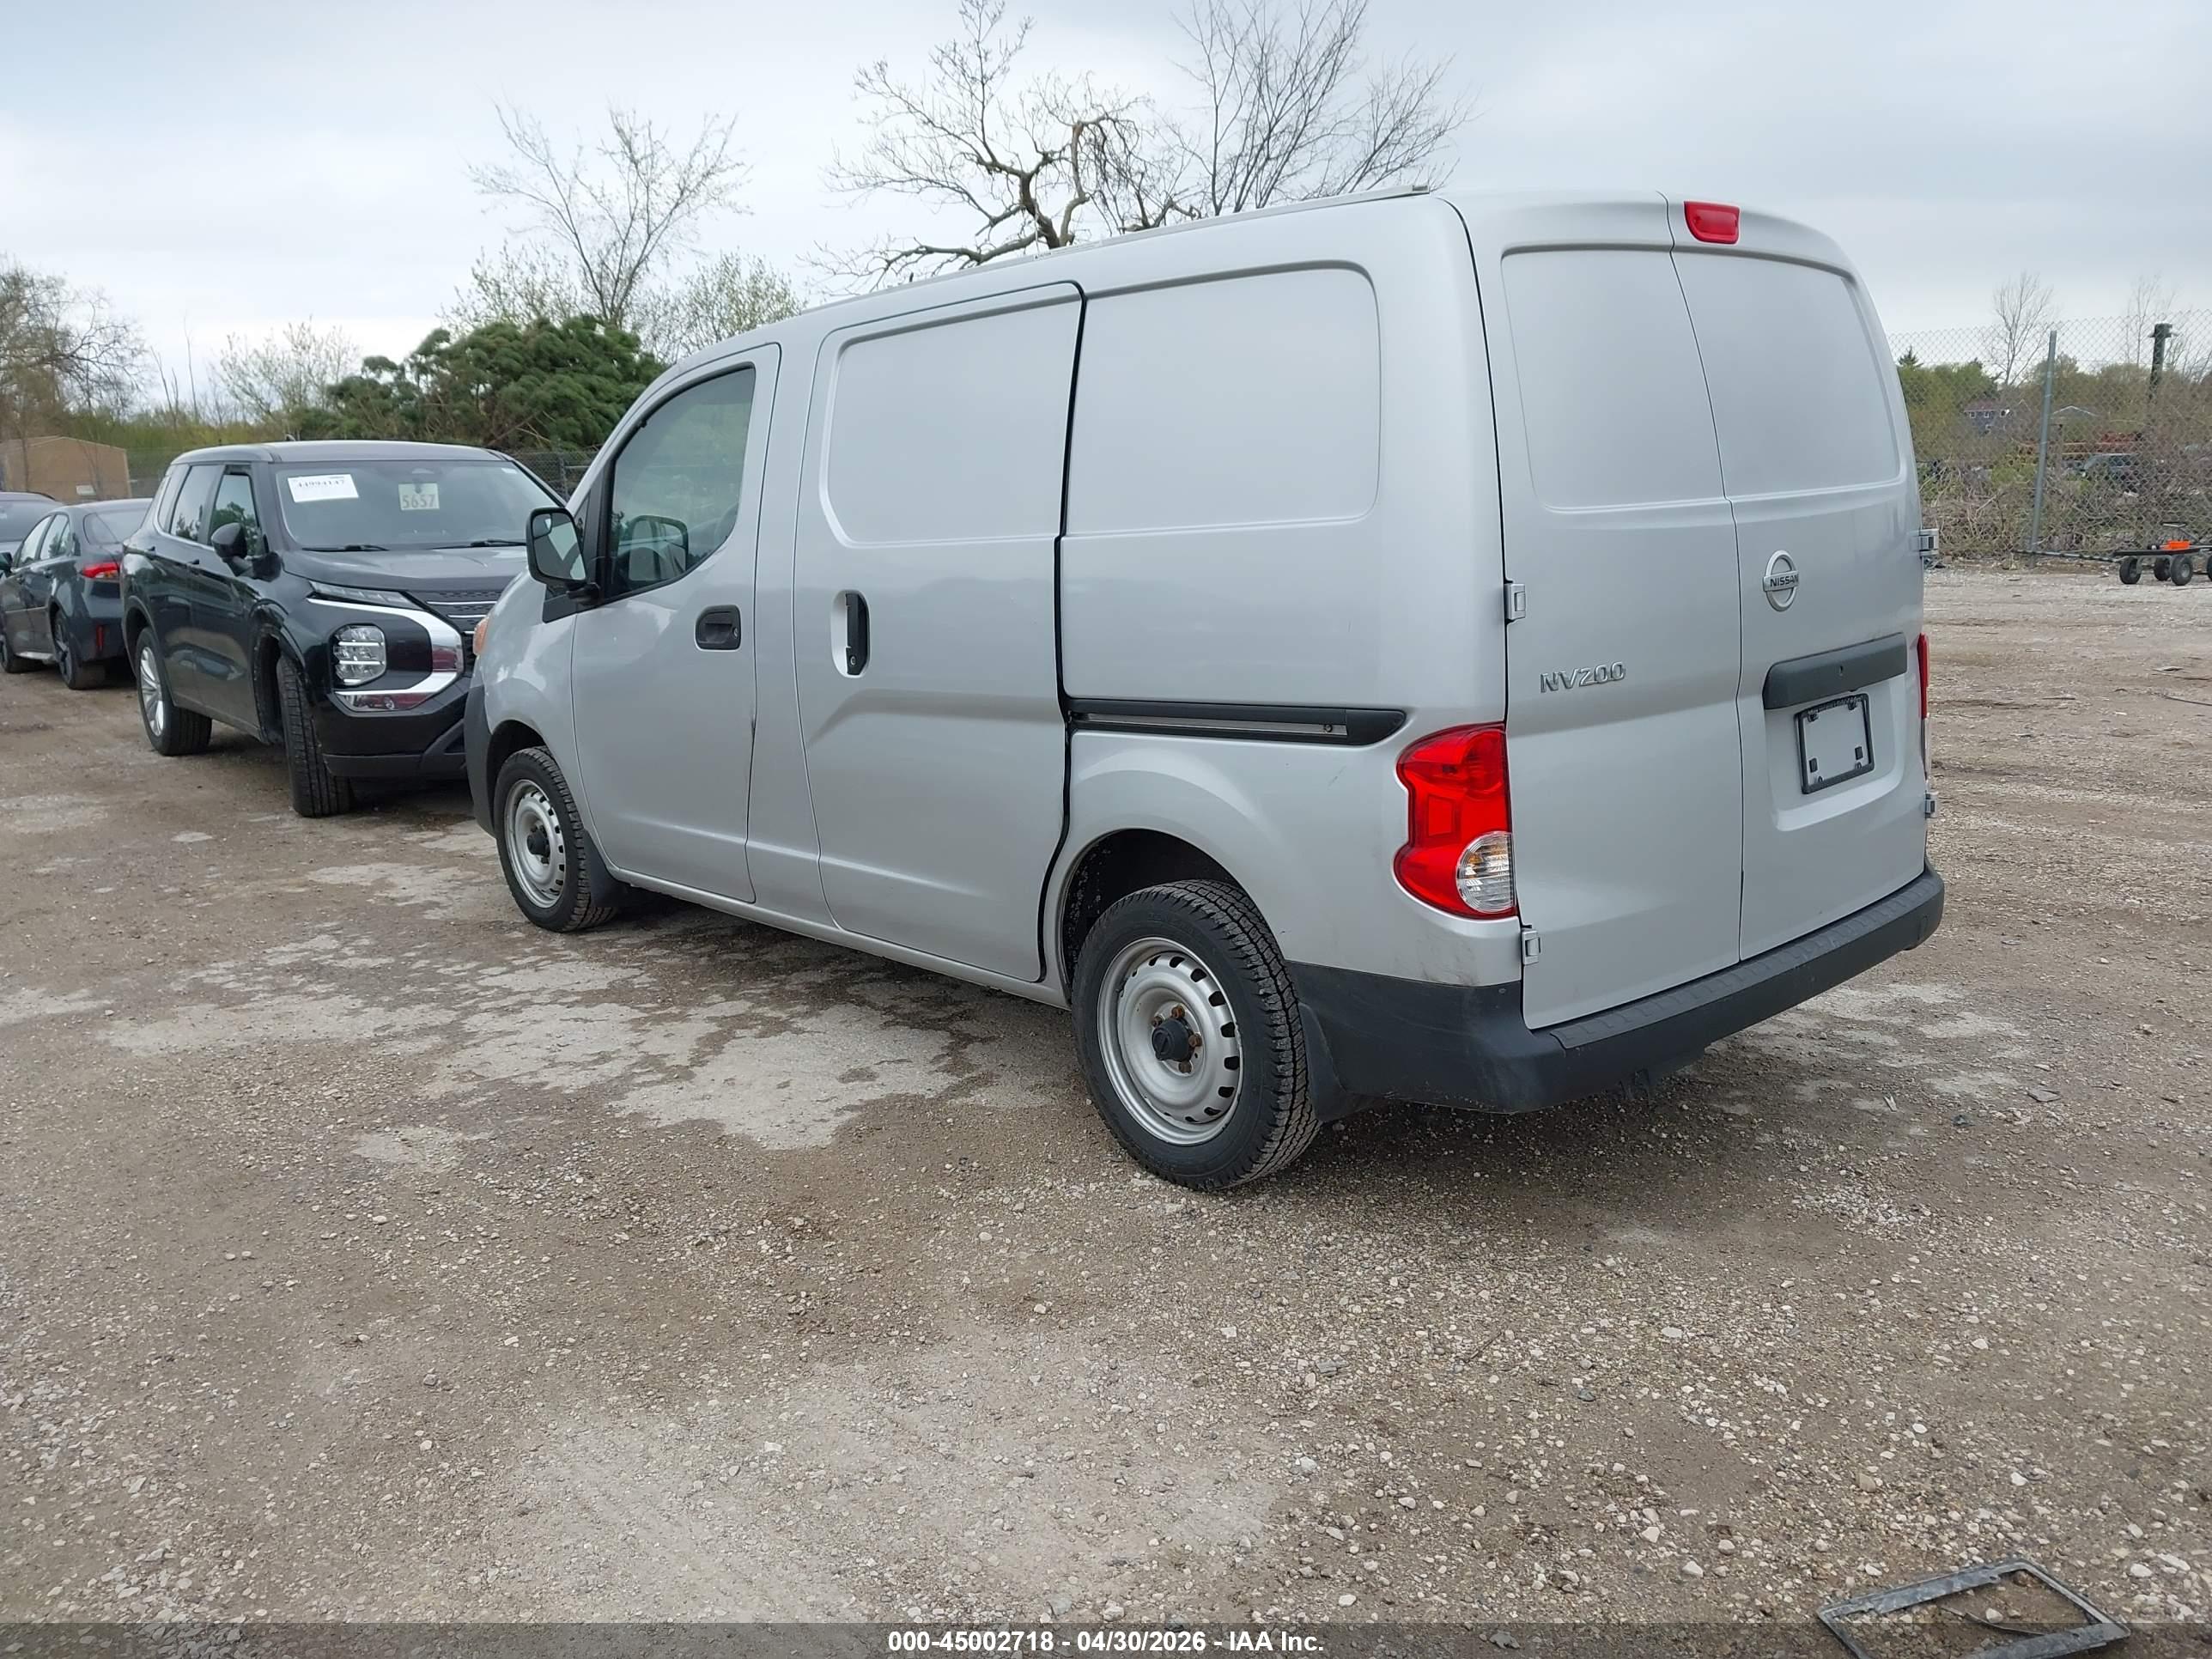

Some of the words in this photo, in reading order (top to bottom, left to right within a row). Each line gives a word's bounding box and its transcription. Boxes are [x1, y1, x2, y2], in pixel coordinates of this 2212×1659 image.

[403, 494, 435, 508] 5657
[1771, 574, 1799, 587] NISSAN
[1540, 661, 1626, 693] NV200
